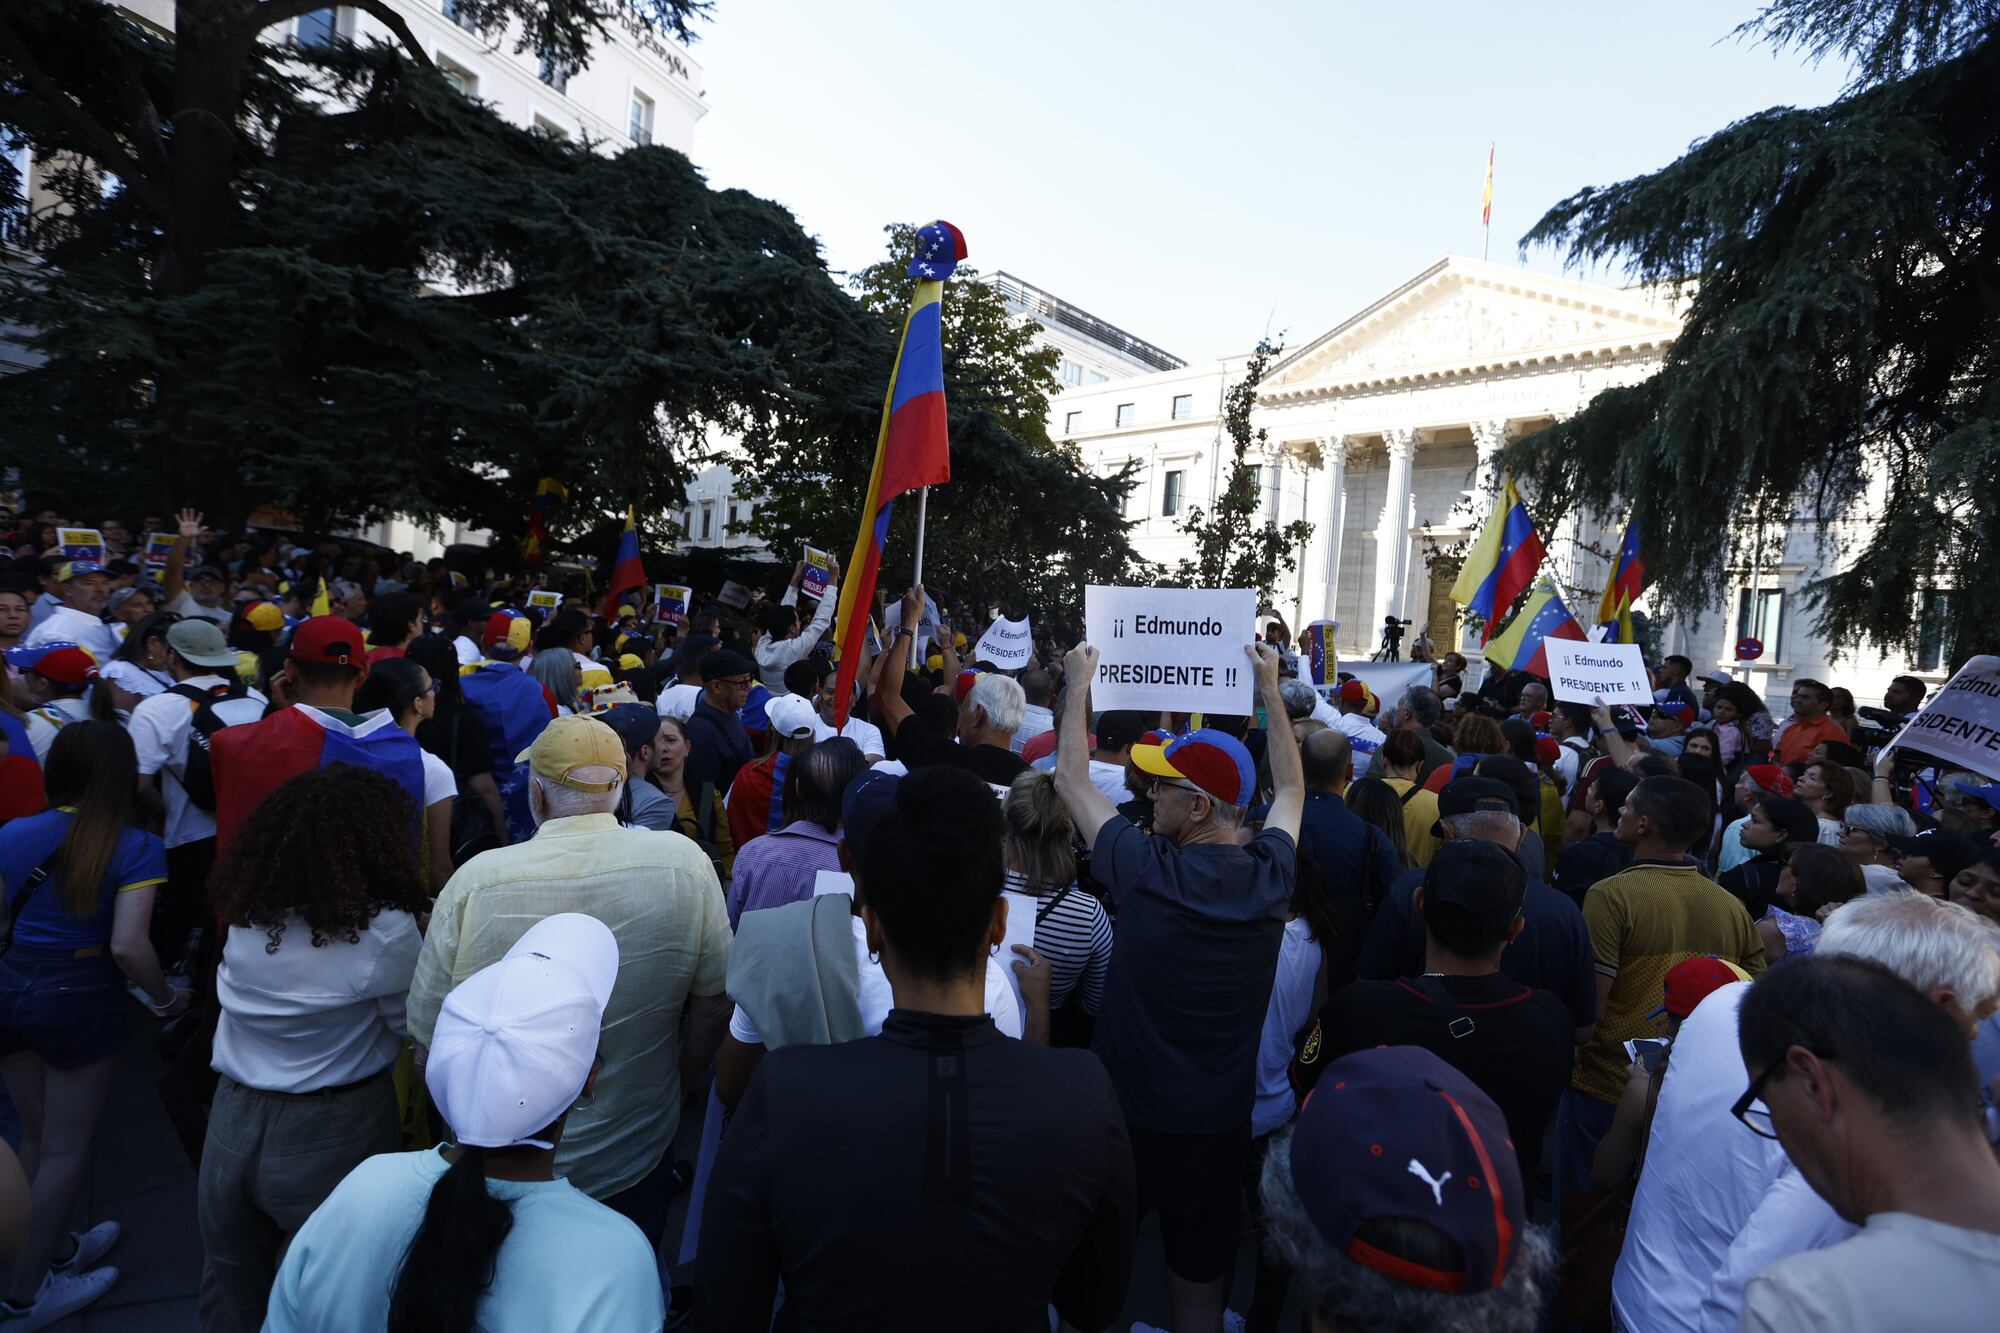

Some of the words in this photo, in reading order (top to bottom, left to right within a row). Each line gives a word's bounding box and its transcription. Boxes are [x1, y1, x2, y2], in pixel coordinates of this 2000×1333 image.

[1135, 615, 1223, 636] Edmundo
[981, 641, 1026, 658] PRESIDENTE
[1325, 649, 1335, 681] LIBERTAD
[1574, 654, 1624, 668] Edmundo
[1100, 664, 1214, 687] PRESIDENTE
[1225, 668, 1237, 687] !!
[1559, 676, 1627, 693] PRESIDENTE
[1631, 681, 1641, 691] !!
